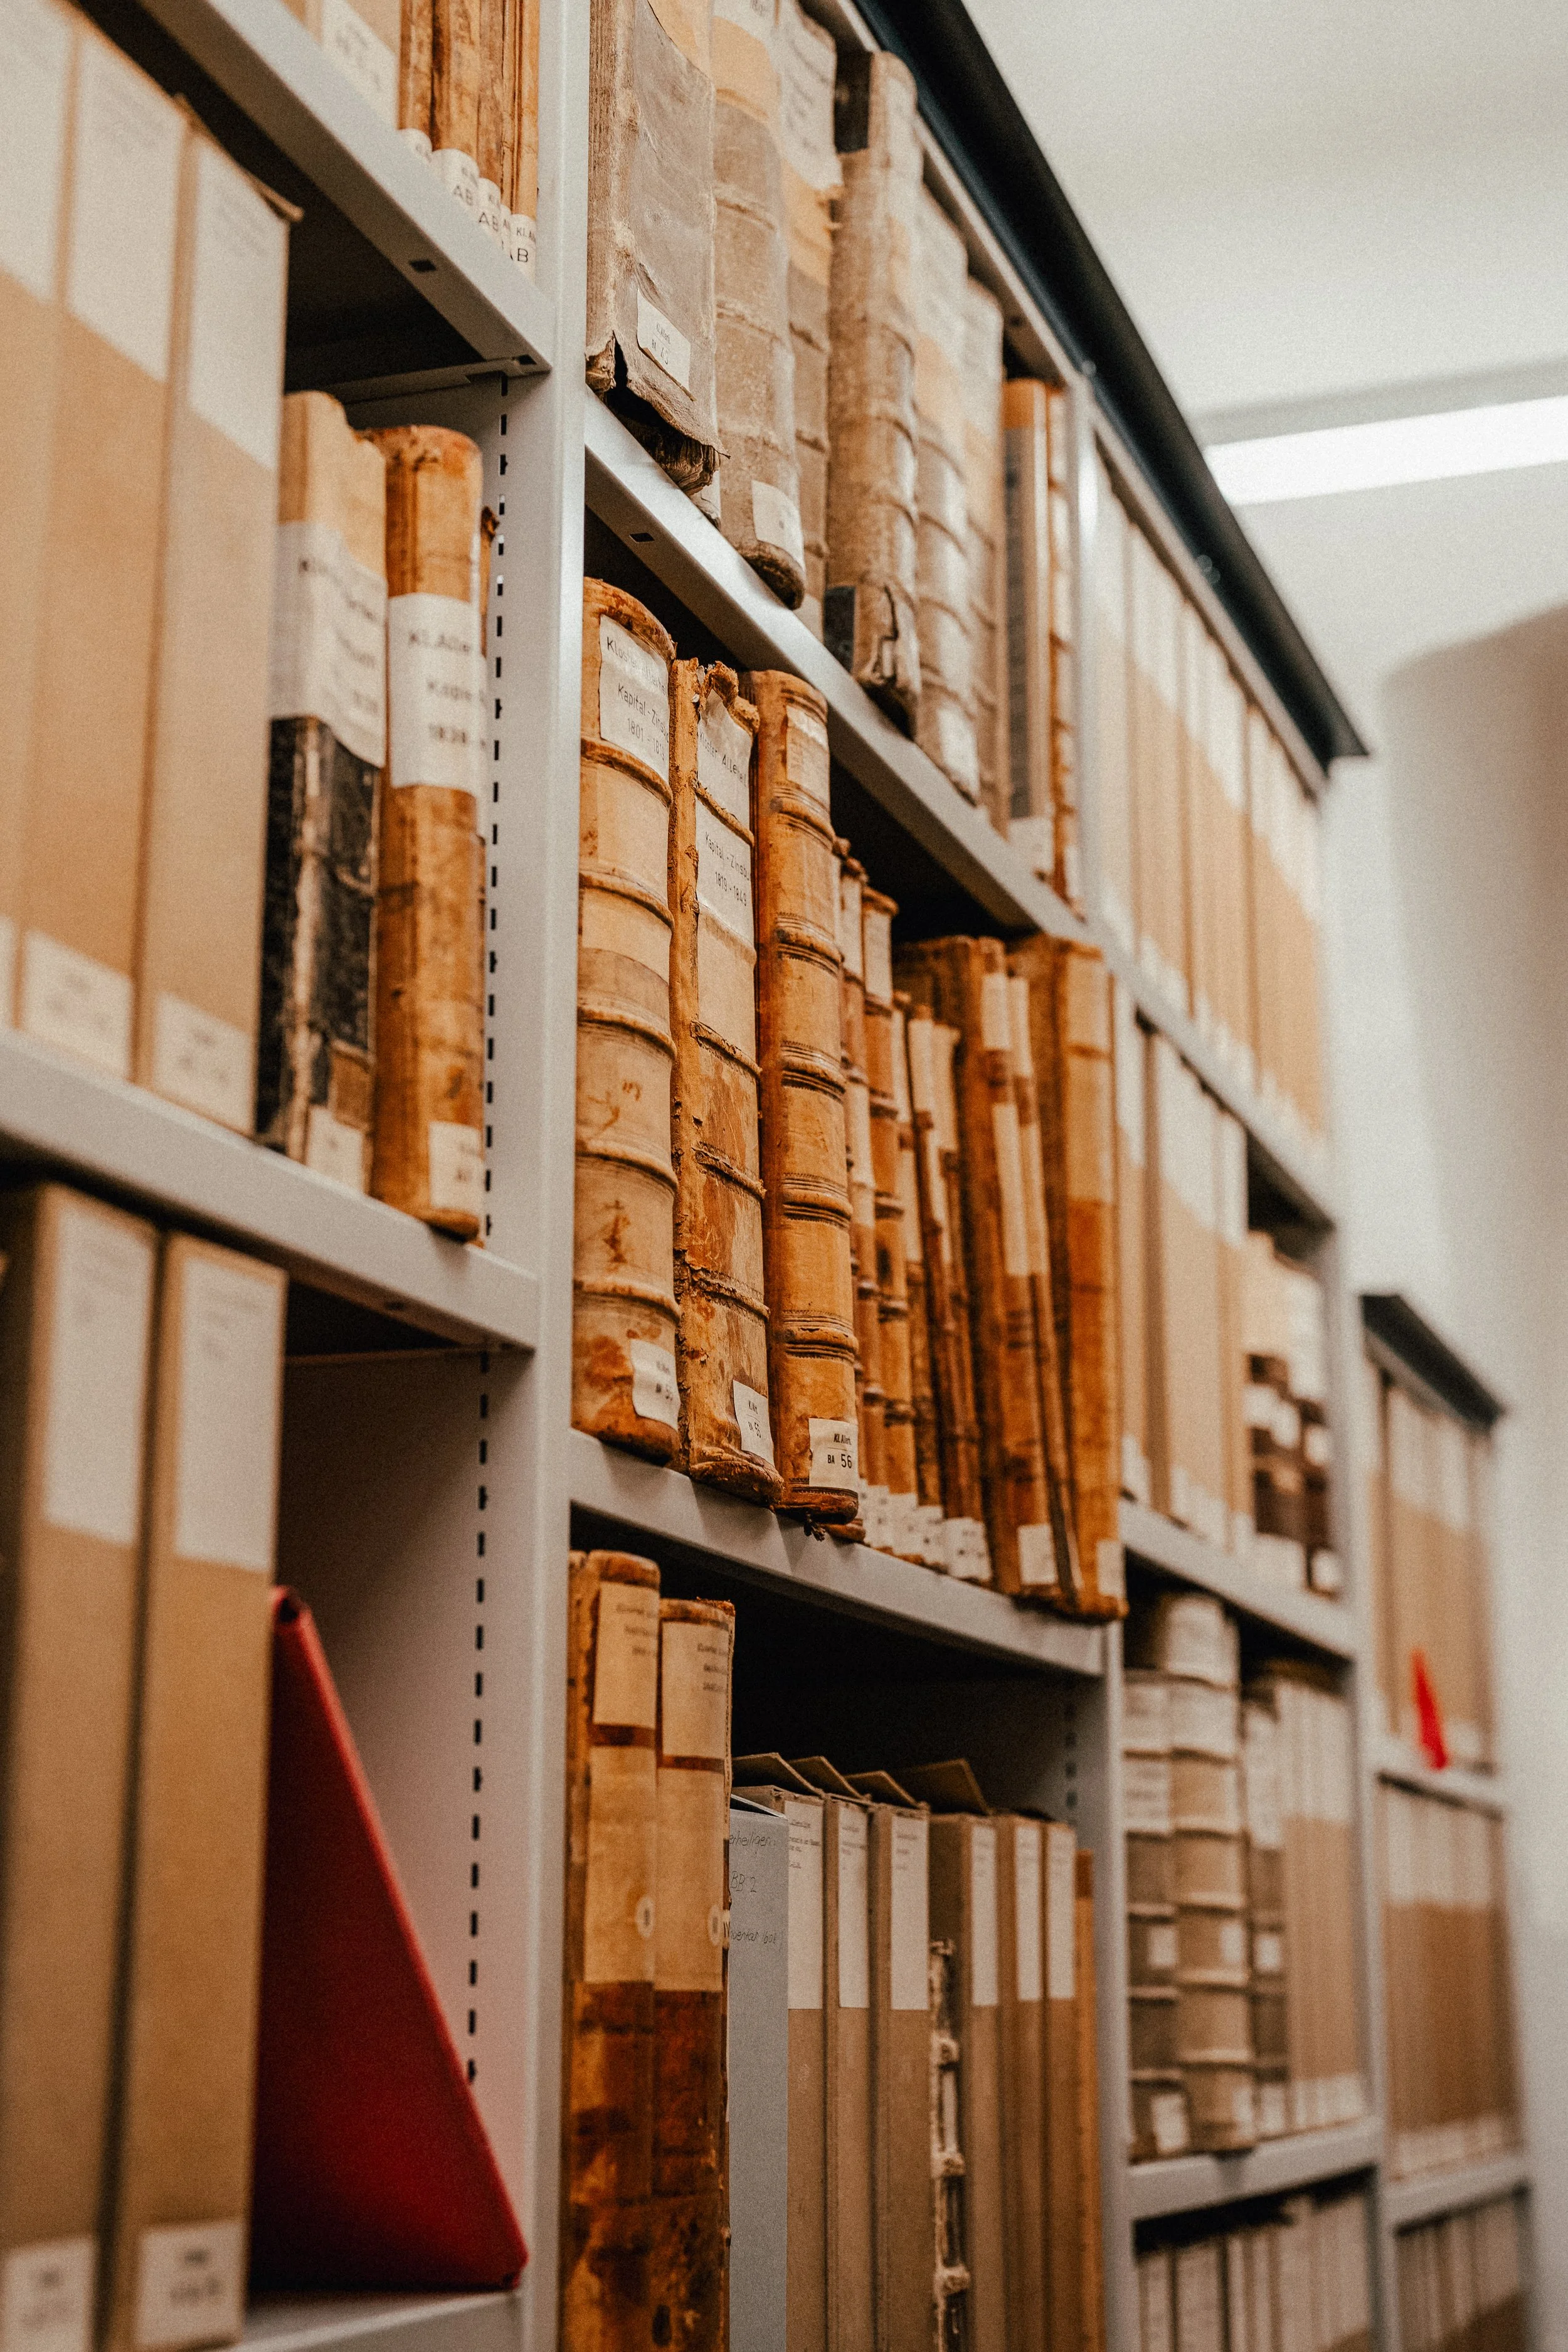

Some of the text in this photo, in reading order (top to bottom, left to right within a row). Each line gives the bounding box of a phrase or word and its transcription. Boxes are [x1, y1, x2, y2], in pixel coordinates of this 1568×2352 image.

[618, 682, 646, 716] Kapital
[628, 718, 644, 742] 1801
[705, 832, 724, 861] Kapital
[716, 871, 727, 892] 1819
[755, 1421, 761, 1439] 55
[827, 1453, 852, 1469] BA 56
[731, 1870, 757, 1893] BB 2
